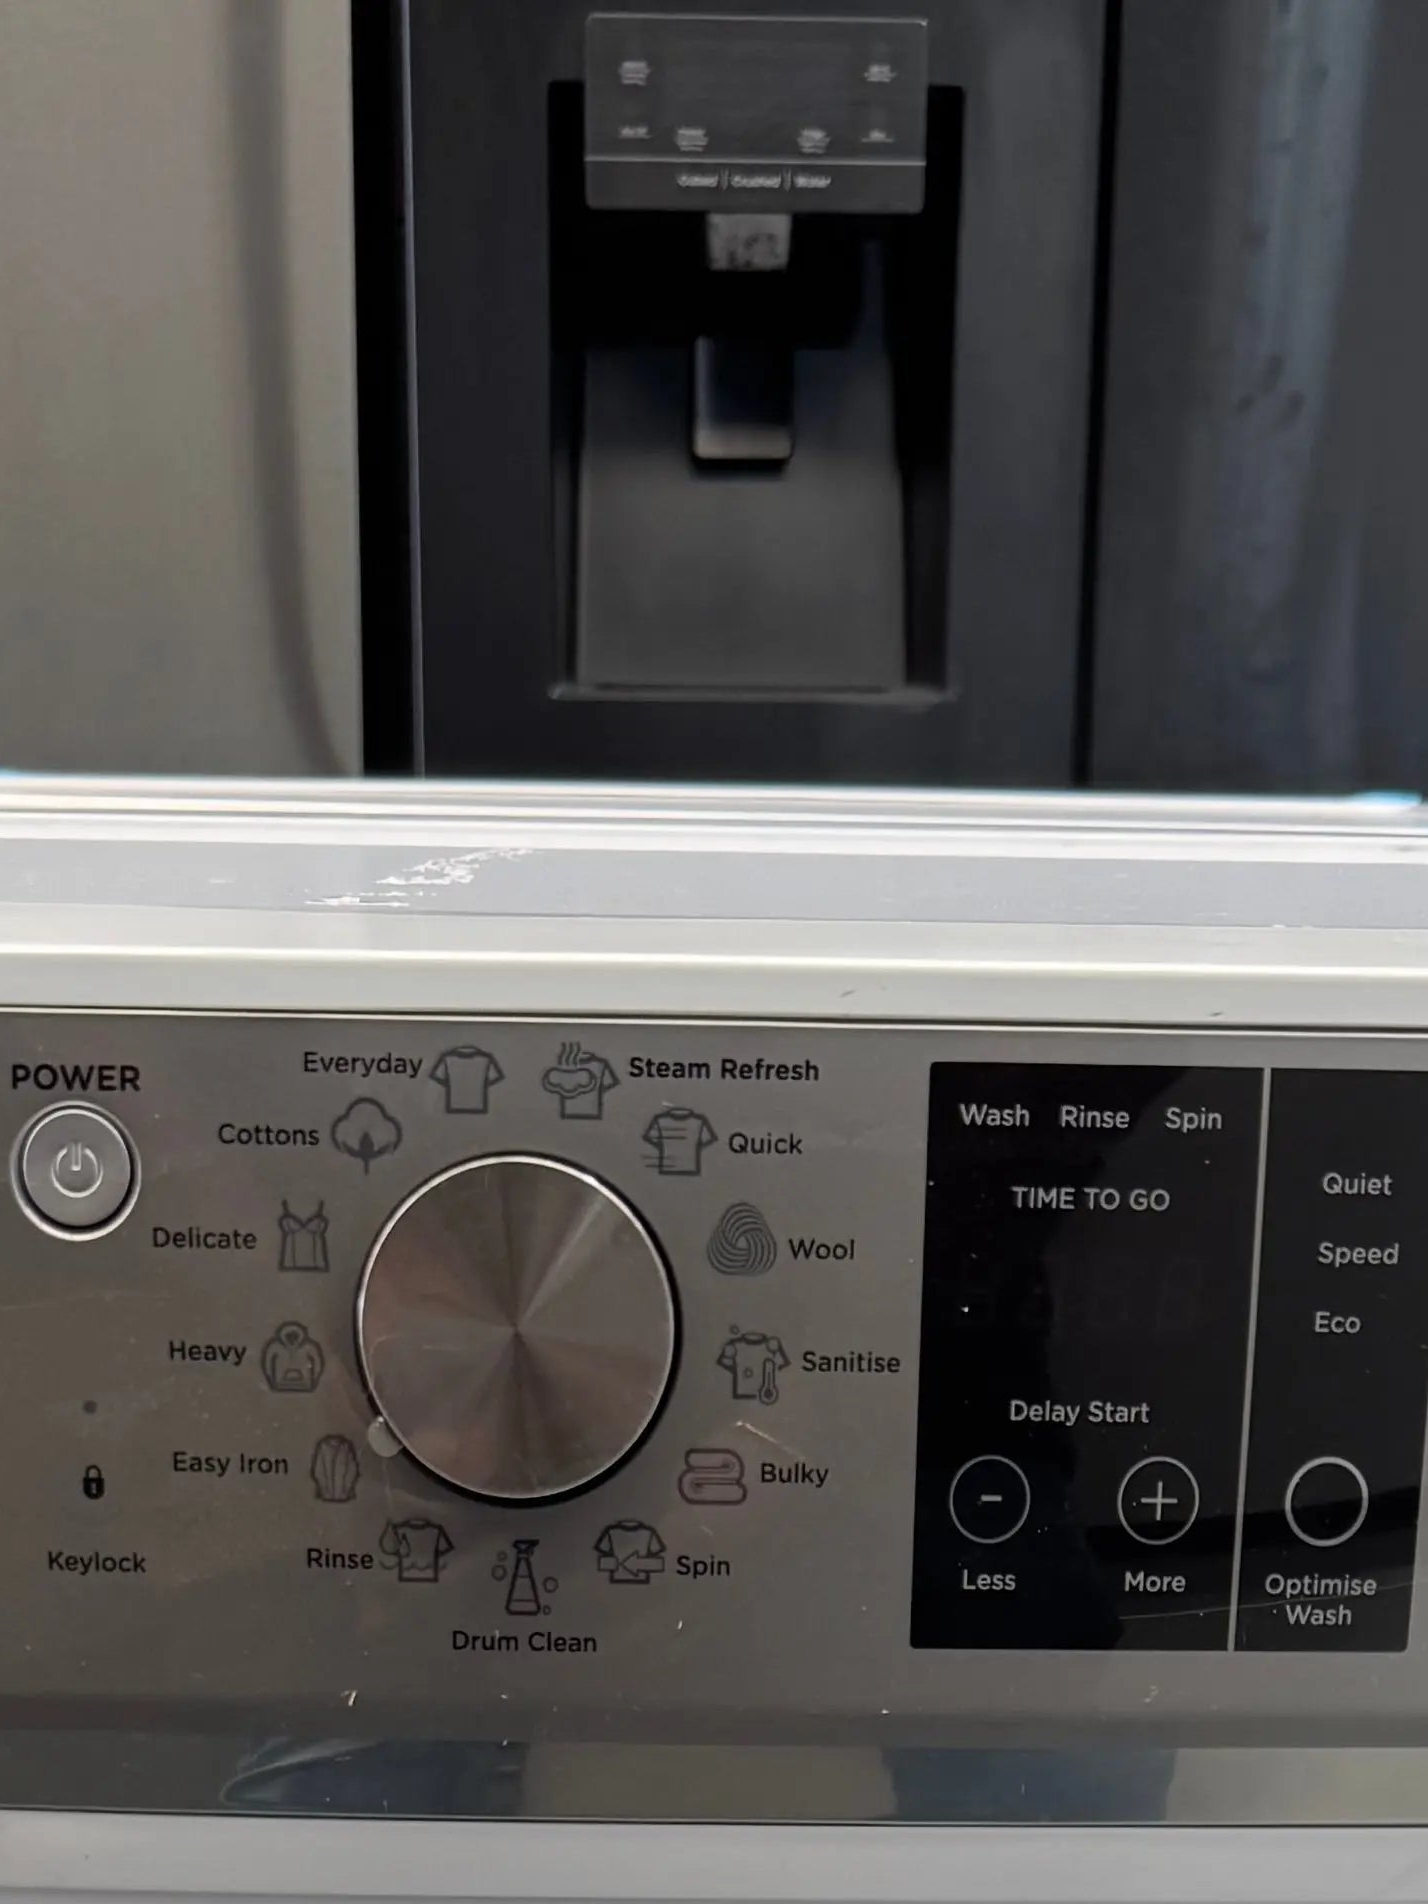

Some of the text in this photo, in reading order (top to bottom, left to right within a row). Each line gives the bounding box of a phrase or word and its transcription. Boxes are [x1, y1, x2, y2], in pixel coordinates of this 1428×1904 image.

[303, 1051, 423, 1079] Everyday
[629, 1056, 820, 1082] Steam Refresh
[11, 1063, 140, 1093] POWER
[960, 1103, 1030, 1128] Wash
[1060, 1105, 1130, 1129] Rinse
[1165, 1107, 1223, 1133] Spin
[218, 1123, 320, 1147] Cottons
[728, 1132, 803, 1156] Quick
[1322, 1172, 1393, 1197] Quiet
[1012, 1186, 1170, 1212] TIME TO GO
[152, 1226, 257, 1250] Delicate
[788, 1237, 855, 1261] Wool
[1317, 1242, 1400, 1268] Speed
[1314, 1312, 1361, 1335] Eco
[169, 1340, 247, 1367] Heavy
[801, 1350, 901, 1374] Sanitise
[1010, 1400, 1150, 1427] Delay Start
[172, 1451, 289, 1477] Easy Iron
[760, 1462, 829, 1488] Bulky
[47, 1550, 147, 1576] Keylock
[306, 1547, 374, 1571] Rinse
[676, 1554, 731, 1581] Spin
[962, 1570, 1016, 1592] Less
[1124, 1572, 1186, 1594] More
[1265, 1572, 1377, 1598] Optimise
[1285, 1603, 1352, 1627] Wash
[451, 1629, 598, 1654] Drum Clean
